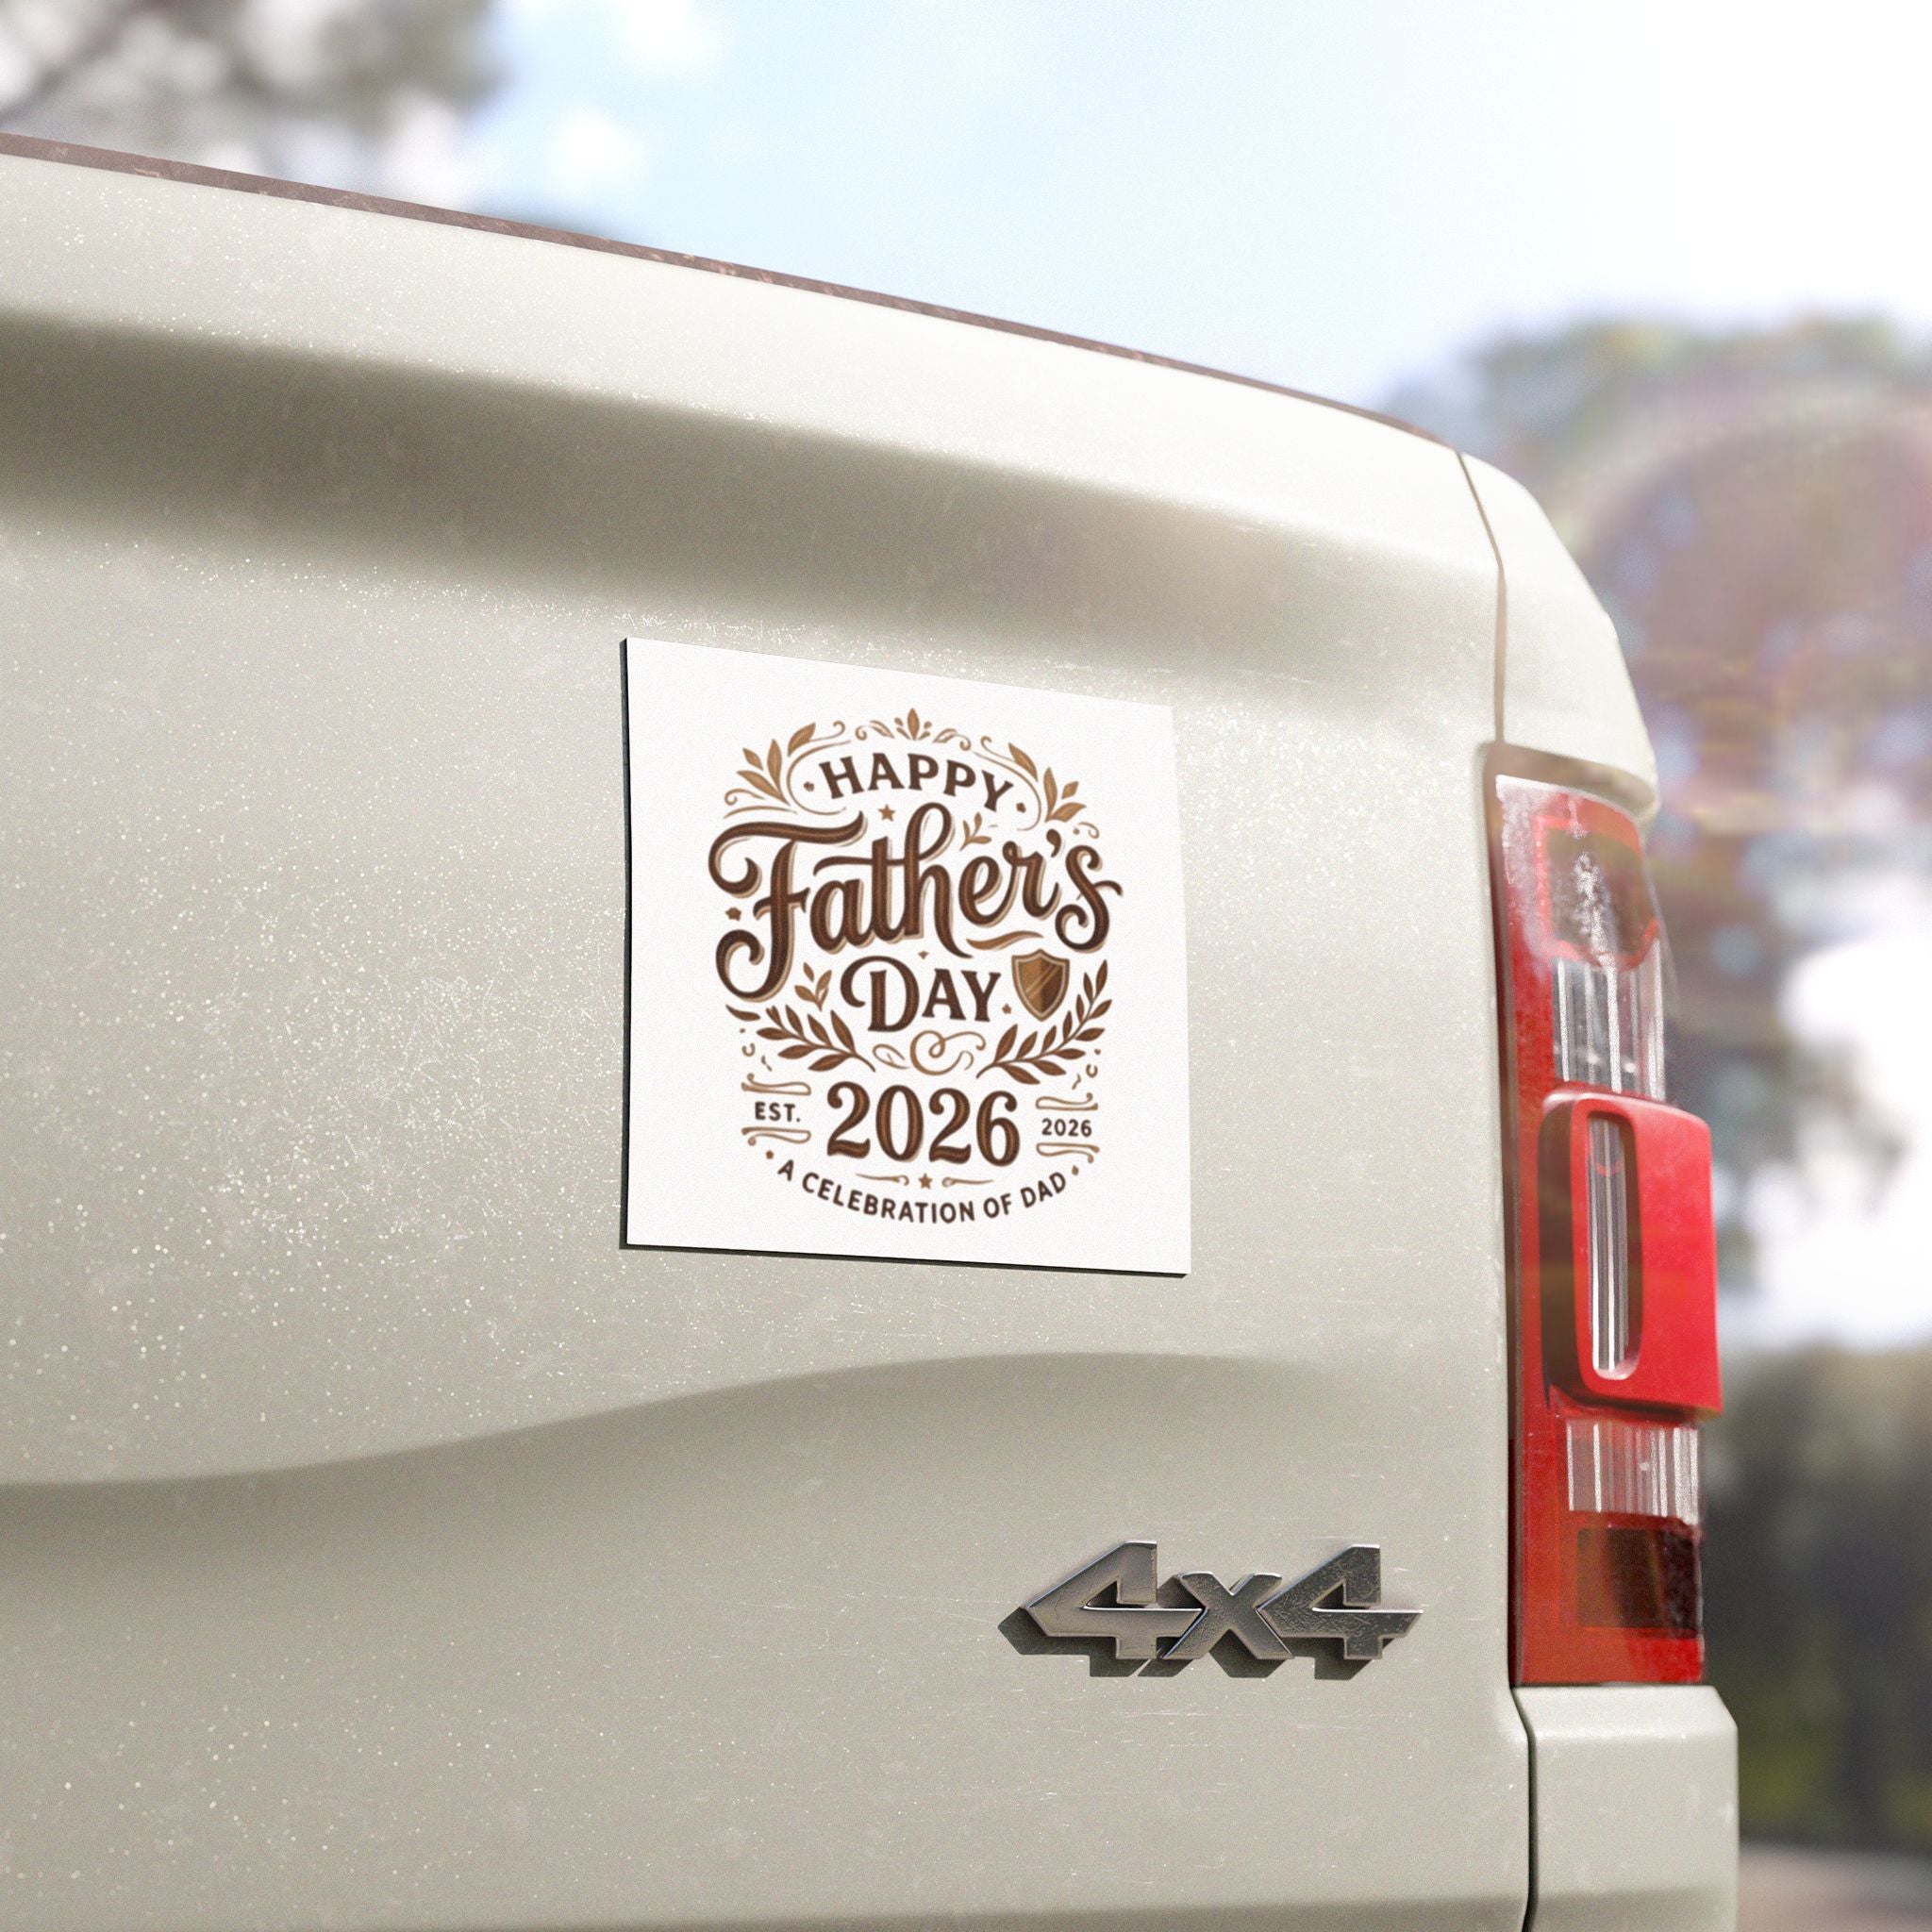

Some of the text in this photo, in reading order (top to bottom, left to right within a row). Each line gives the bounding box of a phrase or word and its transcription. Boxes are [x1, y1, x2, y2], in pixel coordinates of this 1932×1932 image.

[819, 753, 1014, 812] HAPPY
[708, 802, 1124, 1000] Father's
[841, 956, 1002, 1033] DAY
[755, 1102, 801, 1123] EST.
[826, 1081, 1021, 1167] 2026
[1041, 1118, 1092, 1138] 2026
[777, 1158, 1067, 1224] A CELEBRATION OF DAD
